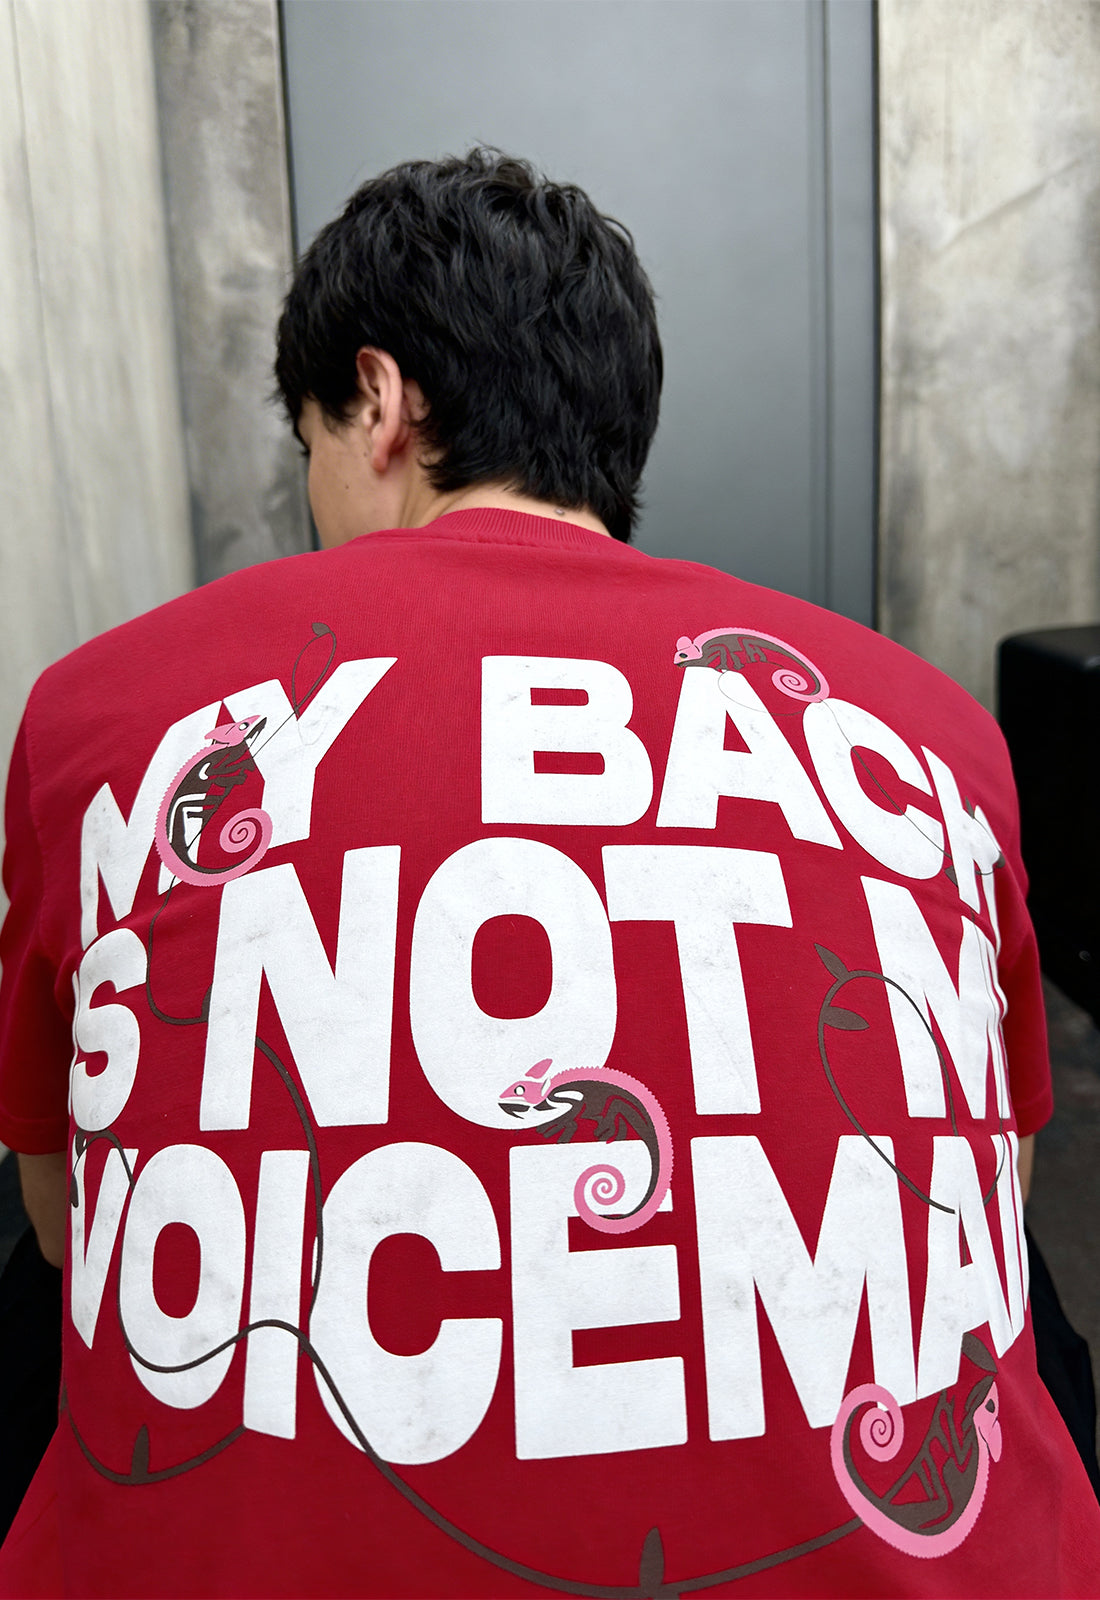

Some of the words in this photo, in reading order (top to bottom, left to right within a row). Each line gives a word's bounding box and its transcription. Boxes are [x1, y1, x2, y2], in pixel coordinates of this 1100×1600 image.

[80, 657, 398, 951] MY
[481, 654, 1002, 959] BACK
[200, 836, 793, 1132] NOT
[860, 875, 1010, 1121] M
